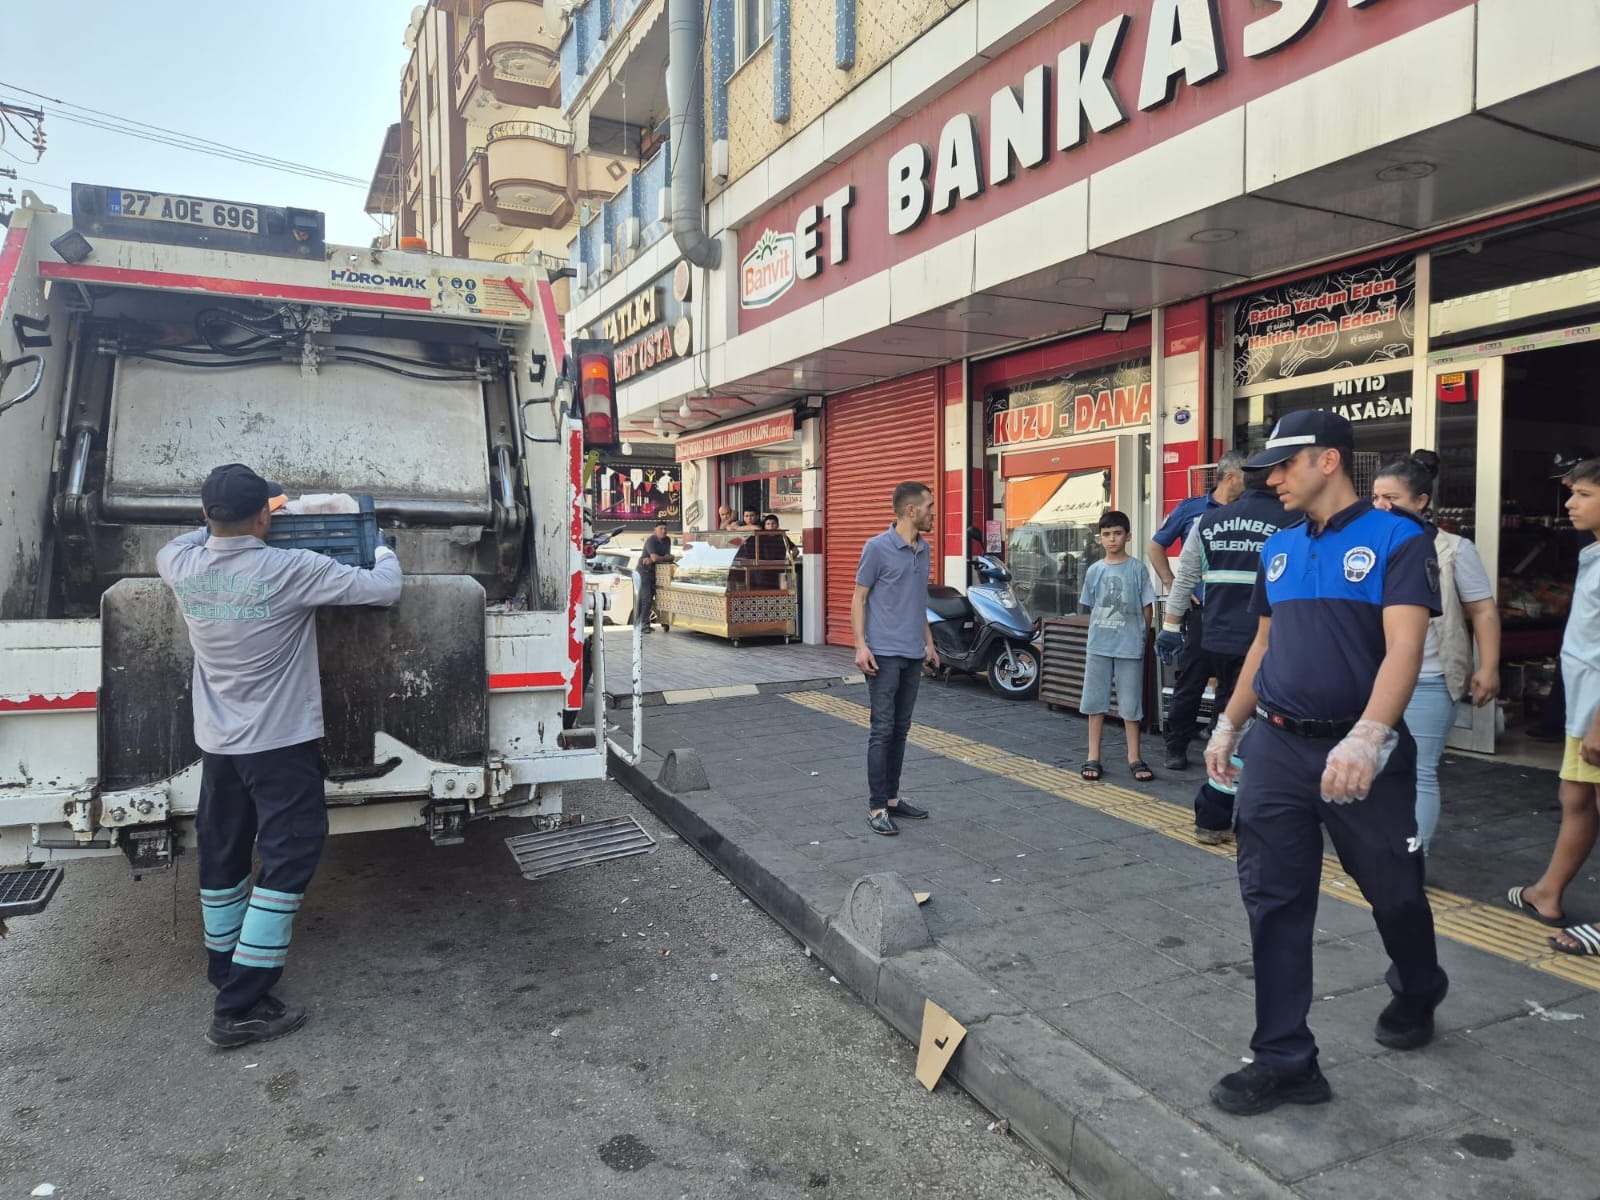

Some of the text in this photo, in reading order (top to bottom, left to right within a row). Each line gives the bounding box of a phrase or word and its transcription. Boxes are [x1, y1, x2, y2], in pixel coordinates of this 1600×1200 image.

[796, 0, 1386, 280] ET BANKA
[122, 193, 255, 230] 27 AOE 696
[745, 247, 790, 296] Banvit
[603, 284, 657, 345] TATLICI
[1249, 278, 1396, 325] Batıla Yardım Eden
[639, 325, 673, 371] USTA
[1248, 329, 1294, 350] Hakka
[1296, 320, 1338, 340] Zulm
[993, 400, 1055, 446] KUZU
[1074, 384, 1151, 434] DANA
